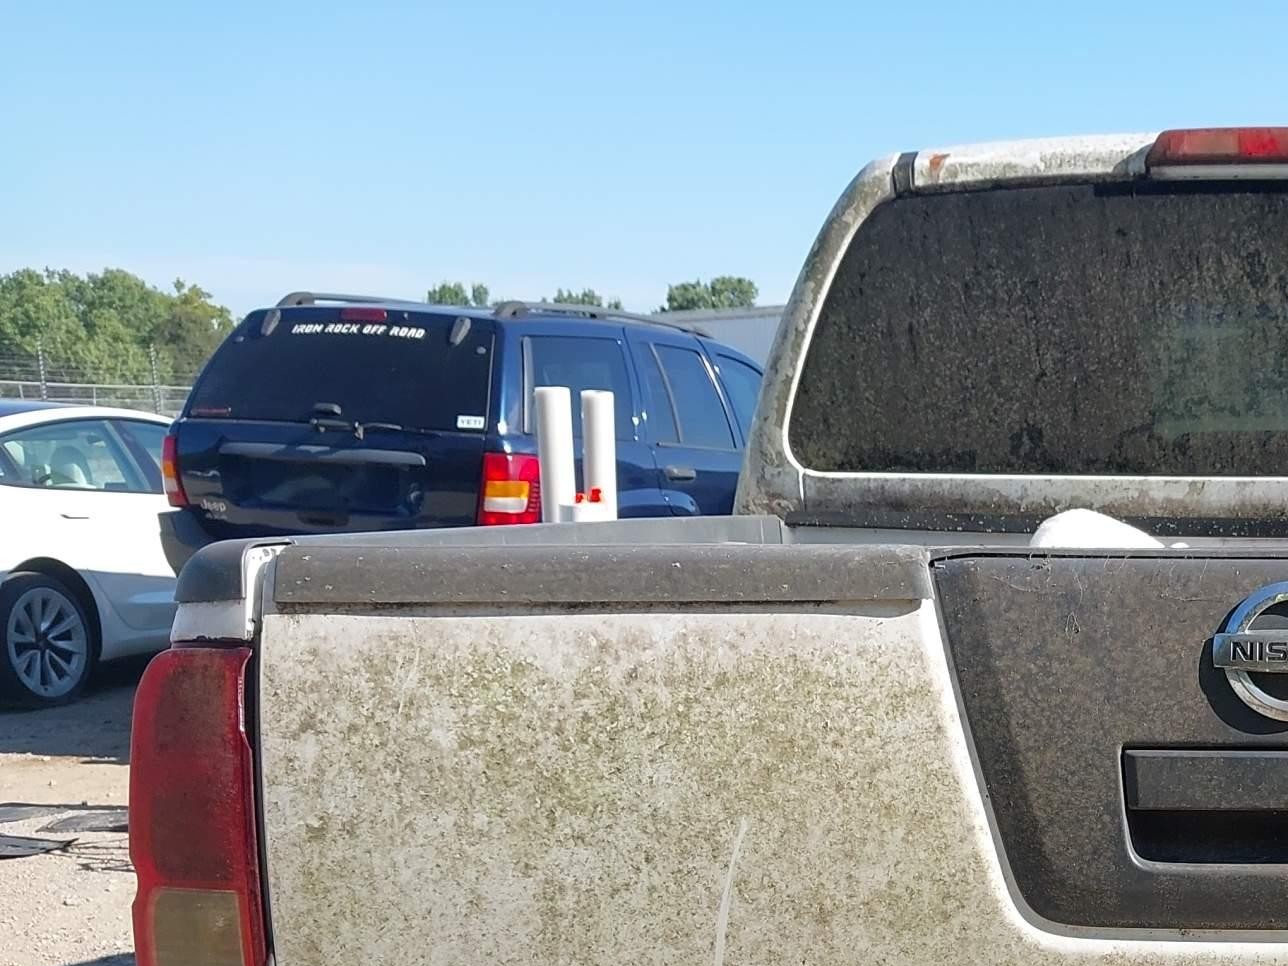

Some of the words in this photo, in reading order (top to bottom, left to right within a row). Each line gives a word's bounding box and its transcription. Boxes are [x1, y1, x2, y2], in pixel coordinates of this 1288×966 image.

[291, 323, 325, 334] IRON
[324, 322, 361, 334] ROCK
[362, 324, 387, 335] OFF
[388, 325, 426, 338] ROAD
[200, 499, 227, 512] Jeep
